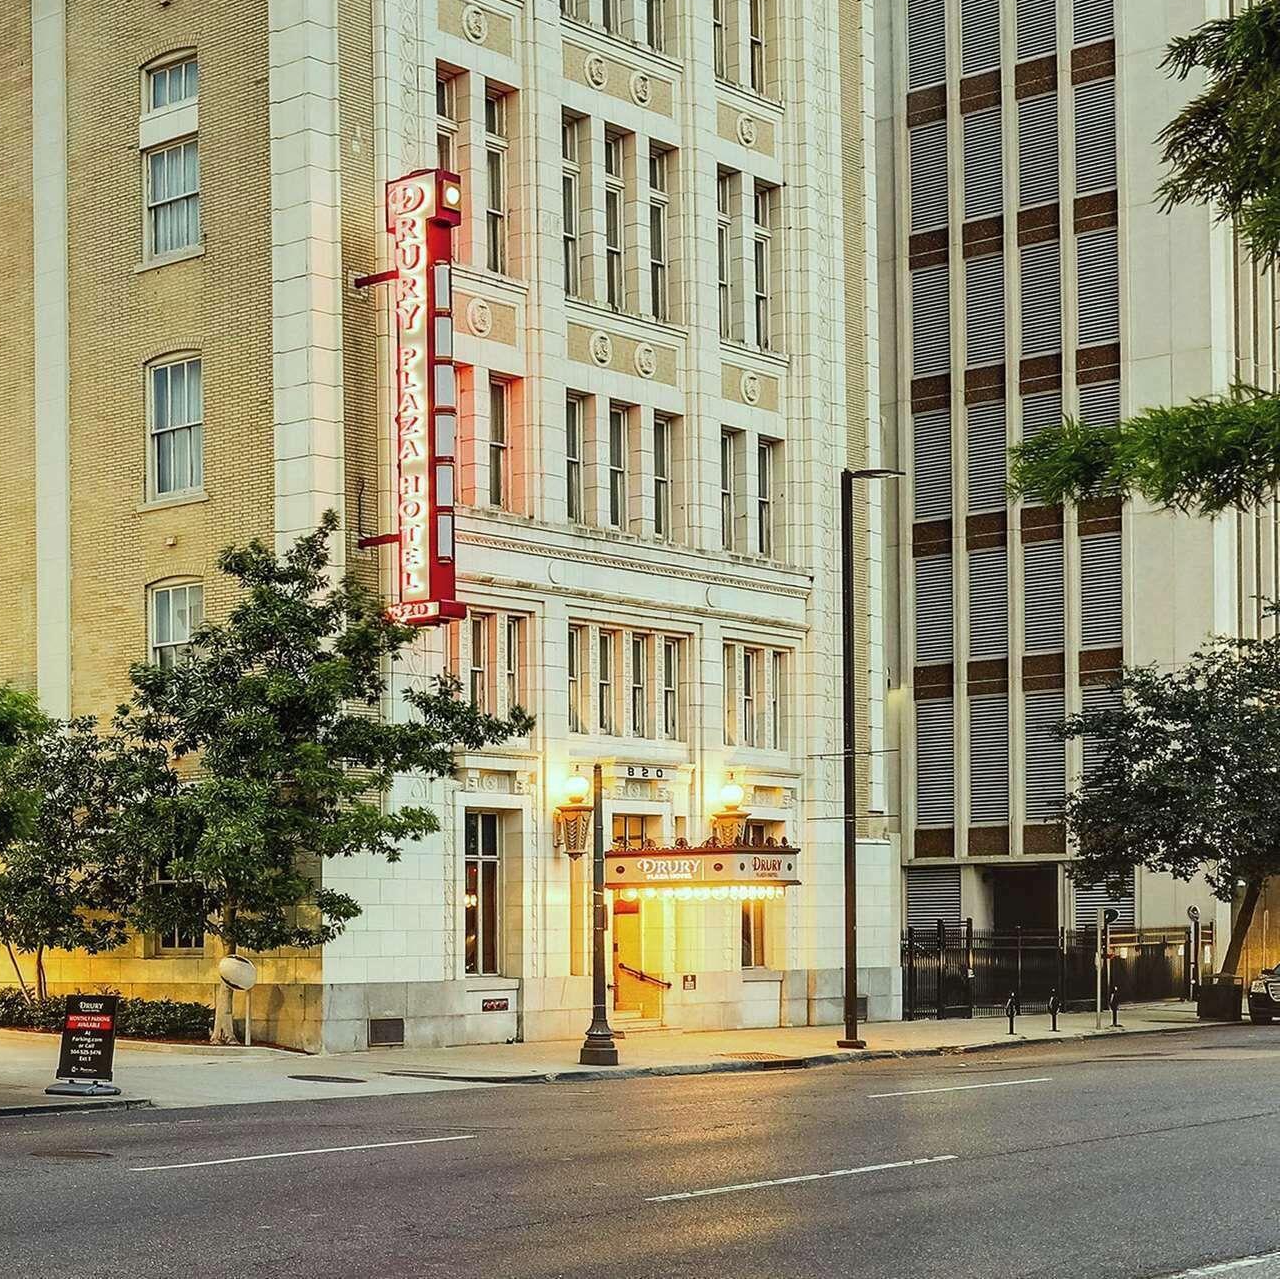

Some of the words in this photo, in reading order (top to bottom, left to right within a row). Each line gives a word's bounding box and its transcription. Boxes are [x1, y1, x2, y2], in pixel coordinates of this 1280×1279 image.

[389, 184, 425, 330] DRURY
[399, 346, 420, 460] PLAZA
[400, 475, 421, 593] HOTEL
[391, 604, 429, 620] 820
[627, 767, 664, 778] 820
[637, 858, 701, 875] DRURY
[752, 856, 783, 872] DRURY
